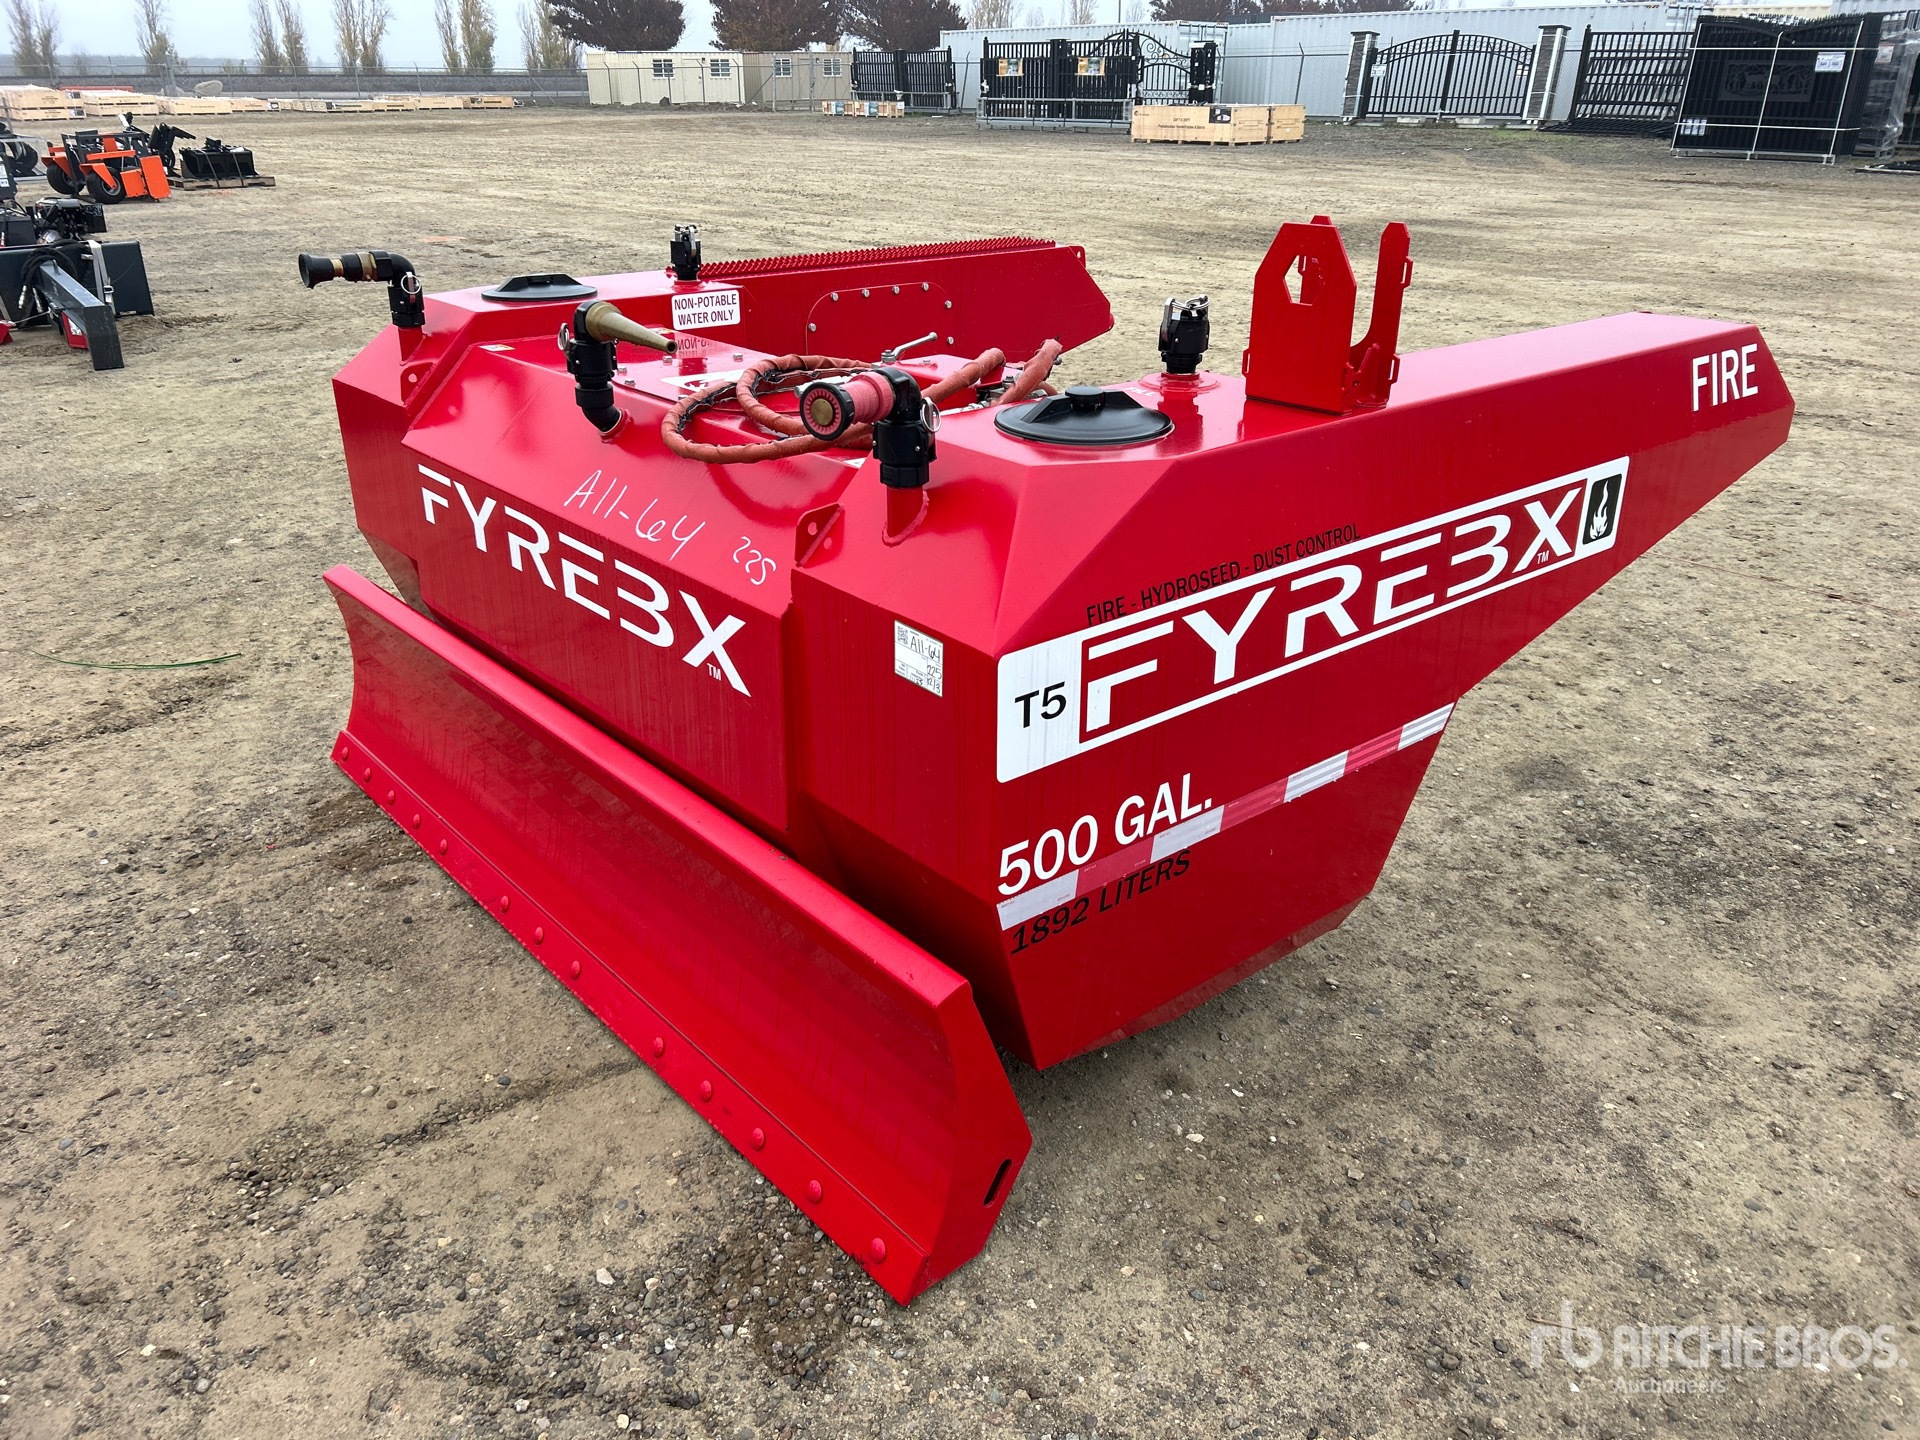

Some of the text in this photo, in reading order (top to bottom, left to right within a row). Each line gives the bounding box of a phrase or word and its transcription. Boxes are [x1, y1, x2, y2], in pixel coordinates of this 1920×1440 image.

[674, 294, 737, 310] NON-POTABLE
[678, 309, 734, 326] WATER ONLY
[1692, 343, 1759, 412] FIRE
[1085, 596, 1128, 627] FIRE
[1140, 560, 1242, 610] HYDROSEED
[1253, 543, 1292, 573] DUST
[1295, 522, 1362, 559] CONTROL
[1014, 681, 1067, 729] T5
[997, 772, 1213, 895] 500 GAL.
[1010, 849, 1192, 955] 1892 LITERS
